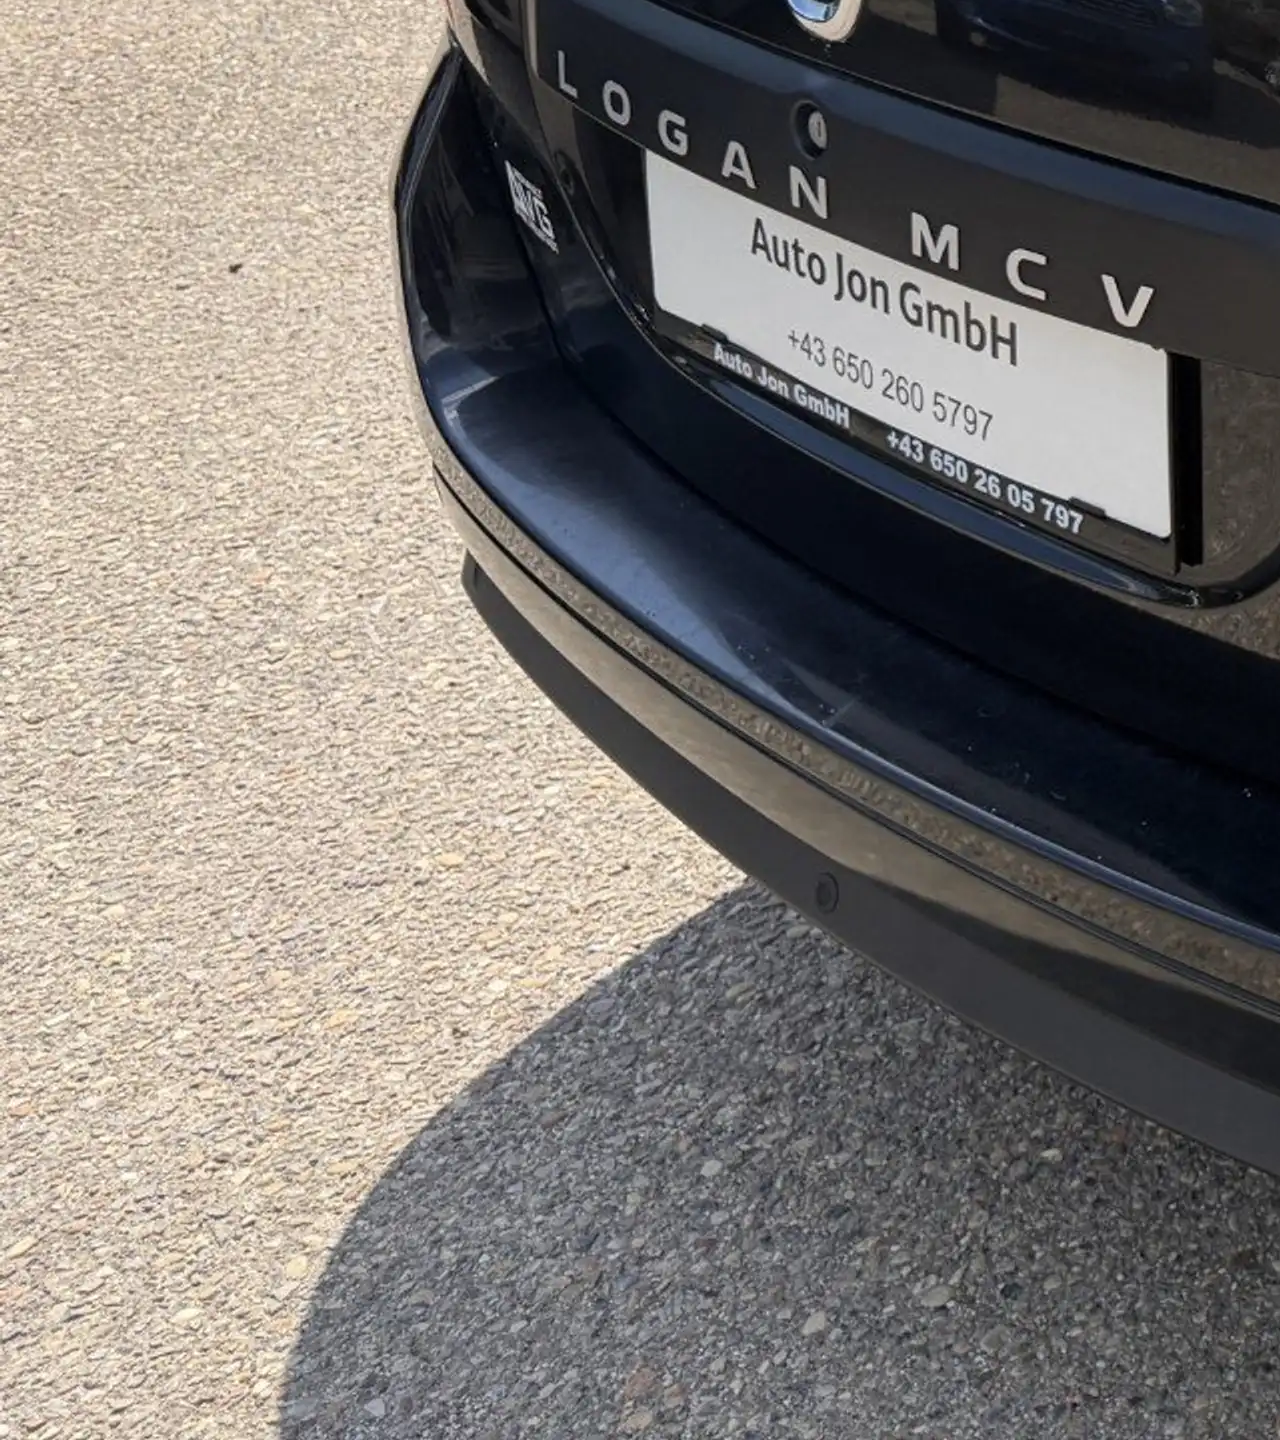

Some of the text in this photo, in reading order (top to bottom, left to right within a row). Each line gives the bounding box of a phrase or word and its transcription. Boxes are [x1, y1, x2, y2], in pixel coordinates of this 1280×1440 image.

[556, 49, 829, 220] LOGAN
[910, 210, 1155, 328] MCV
[750, 216, 1018, 367] Auto Jon GmbH
[713, 341, 1085, 535] Auto Jon GmbH +43 650 26 05 797
[787, 328, 994, 442] +43 650 260 5797
